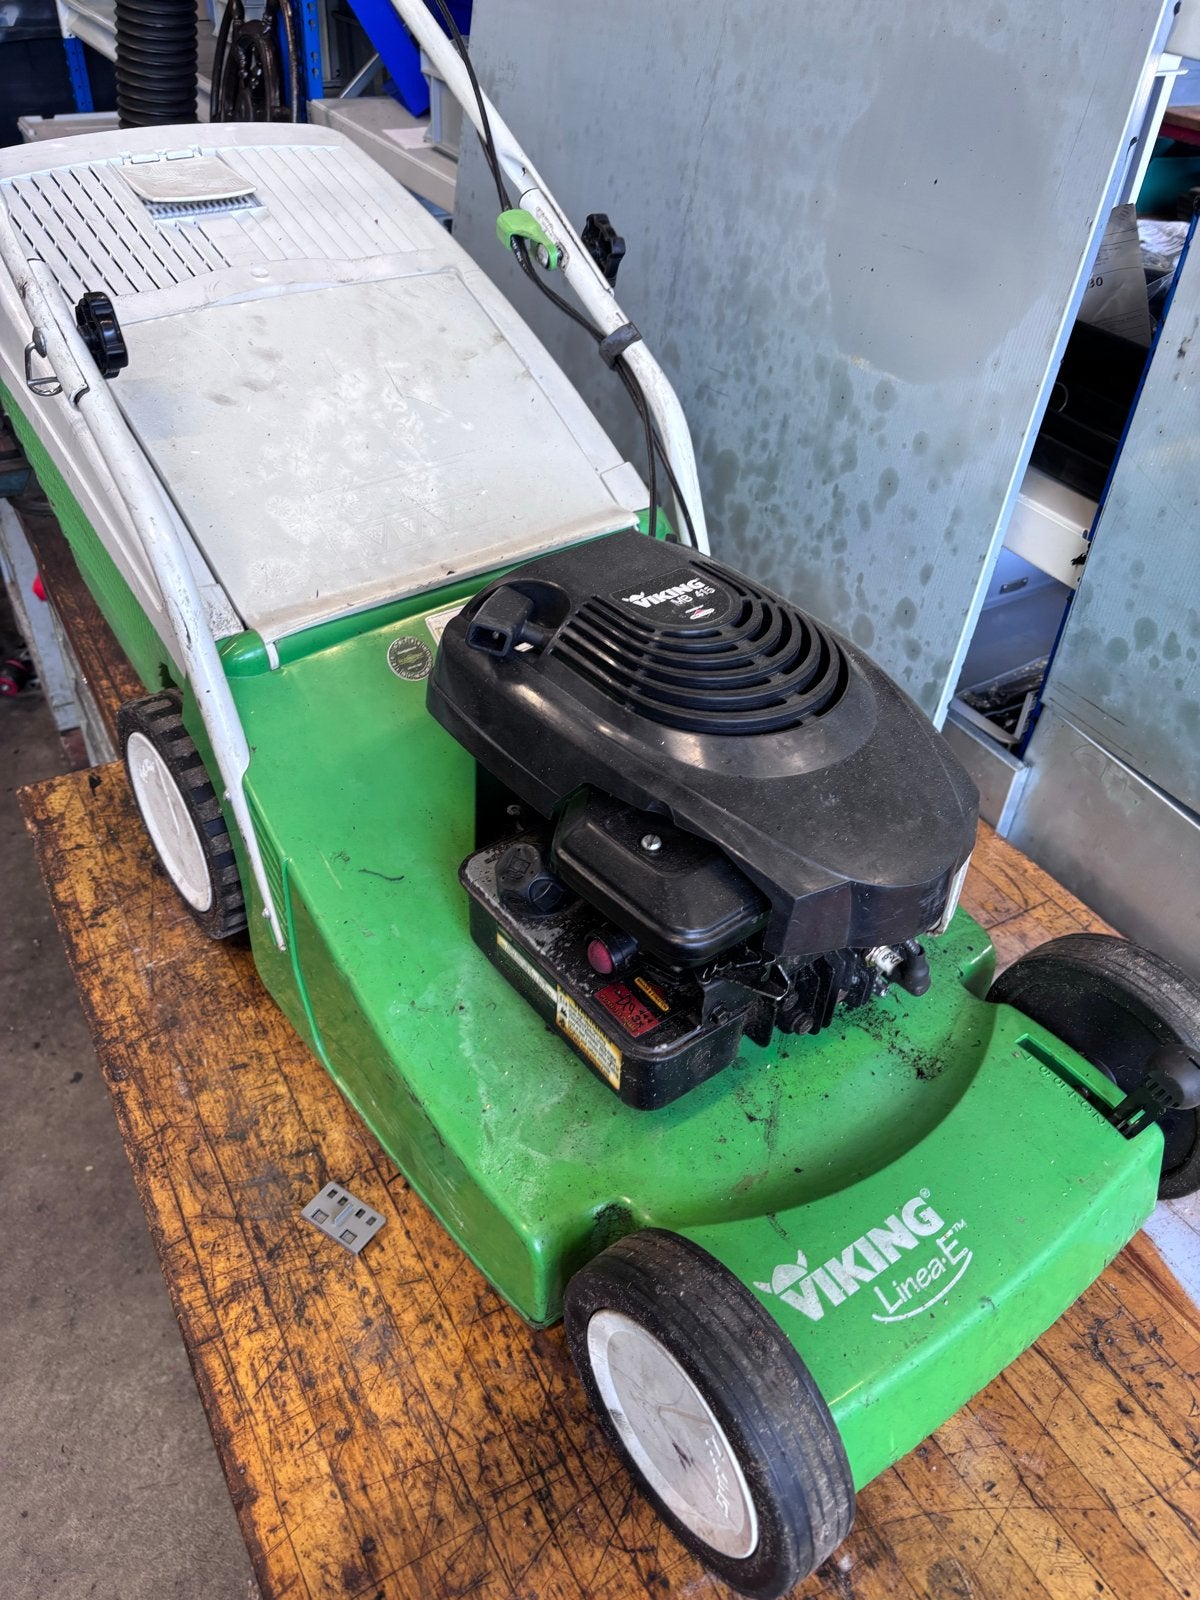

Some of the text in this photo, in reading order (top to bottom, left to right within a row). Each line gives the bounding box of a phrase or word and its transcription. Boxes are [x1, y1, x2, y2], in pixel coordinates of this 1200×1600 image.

[632, 577, 706, 608] VIKING
[669, 585, 716, 606] MB 415
[779, 1196, 945, 1322] VIKING
